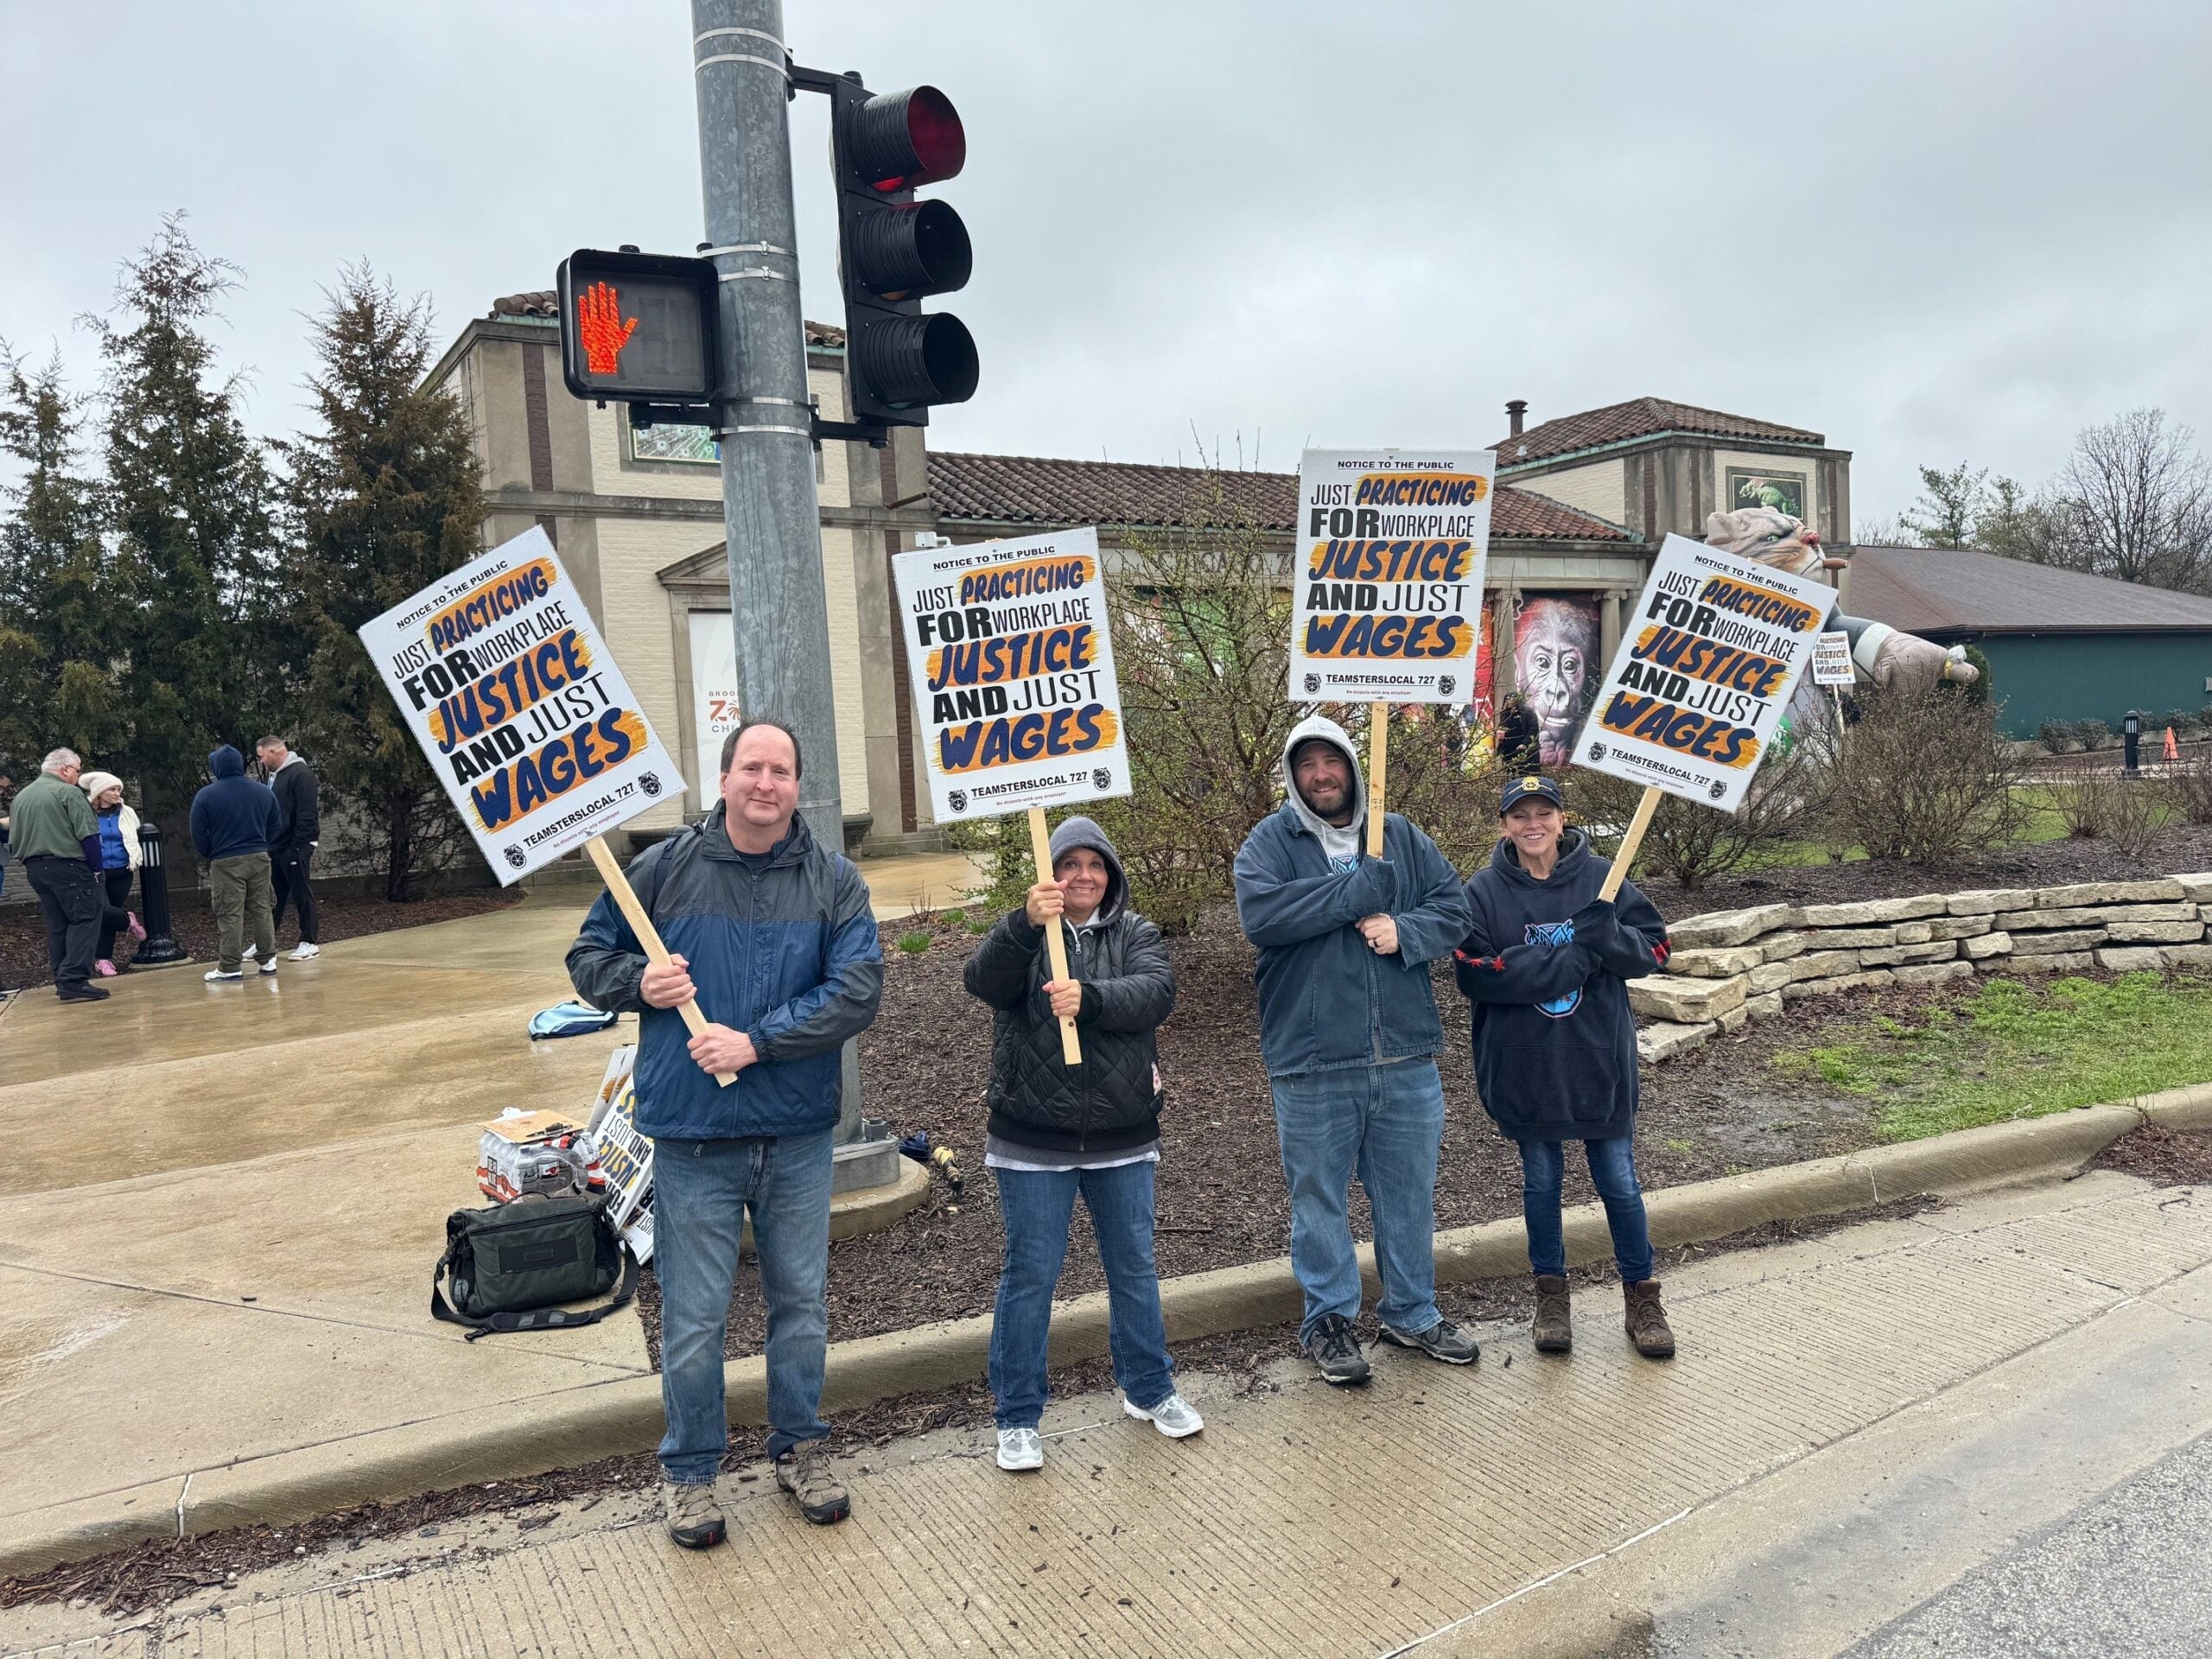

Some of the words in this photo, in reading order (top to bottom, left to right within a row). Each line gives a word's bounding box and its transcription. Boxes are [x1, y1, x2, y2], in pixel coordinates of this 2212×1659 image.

[1311, 485, 1352, 505] JUST
[1355, 480, 1476, 506] PRACTICING
[1311, 508, 1379, 537] FOR
[1382, 515, 1475, 537] WORKPLACE
[933, 557, 972, 569] NOTICE
[975, 555, 990, 563] TO
[992, 551, 1014, 561] THE
[1016, 545, 1055, 557] PUBLIC
[1309, 539, 1471, 582] JUSTICE
[1694, 555, 1730, 572] NOTICE
[1732, 567, 1745, 576] TO
[1746, 572, 1764, 584] THE
[1765, 579, 1798, 594] PUBLIC
[397, 603, 432, 629] NOTICE
[431, 594, 447, 607] TO
[447, 582, 469, 598] THE
[469, 560, 508, 586] PUBLIC
[913, 586, 953, 613] JUST
[961, 562, 1084, 606] PRACTICING
[1306, 583, 1377, 611] AND
[1382, 584, 1470, 612] JUST
[1658, 571, 1701, 598] JUST
[1698, 581, 1810, 632] PRACTICING
[393, 639, 431, 679] JUST
[430, 568, 549, 656] PRACTICING
[917, 607, 993, 646] FOR
[992, 597, 1092, 633] WORKPLACE
[1306, 613, 1464, 658] WAGES
[1646, 591, 1716, 637] FOR
[1713, 618, 1798, 662] WORKPLACE
[402, 650, 480, 711] FOR
[470, 601, 572, 671] WORKPLACE
[928, 625, 1091, 692] JUSTICE
[1630, 626, 1787, 698] JUSTICE
[1815, 650, 1847, 658] JUSTICE
[1816, 665, 1849, 674] WAGES
[438, 629, 588, 754] JUSTICE
[933, 686, 1007, 723] AND
[1014, 670, 1100, 710] JUST
[1418, 676, 1435, 684] 727
[1618, 661, 1689, 702] AND
[1688, 685, 1771, 726] JUST
[449, 725, 525, 786] AND
[527, 672, 609, 743] JUST
[940, 703, 1103, 769] WAGES
[1604, 690, 1755, 764] WAGES
[471, 708, 630, 829] WAGES
[614, 782, 634, 798] 727
[1069, 771, 1088, 782] 727
[1694, 774, 1711, 785] 727
[603, 1115, 634, 1146] JUST
[627, 1135, 652, 1166] AND
